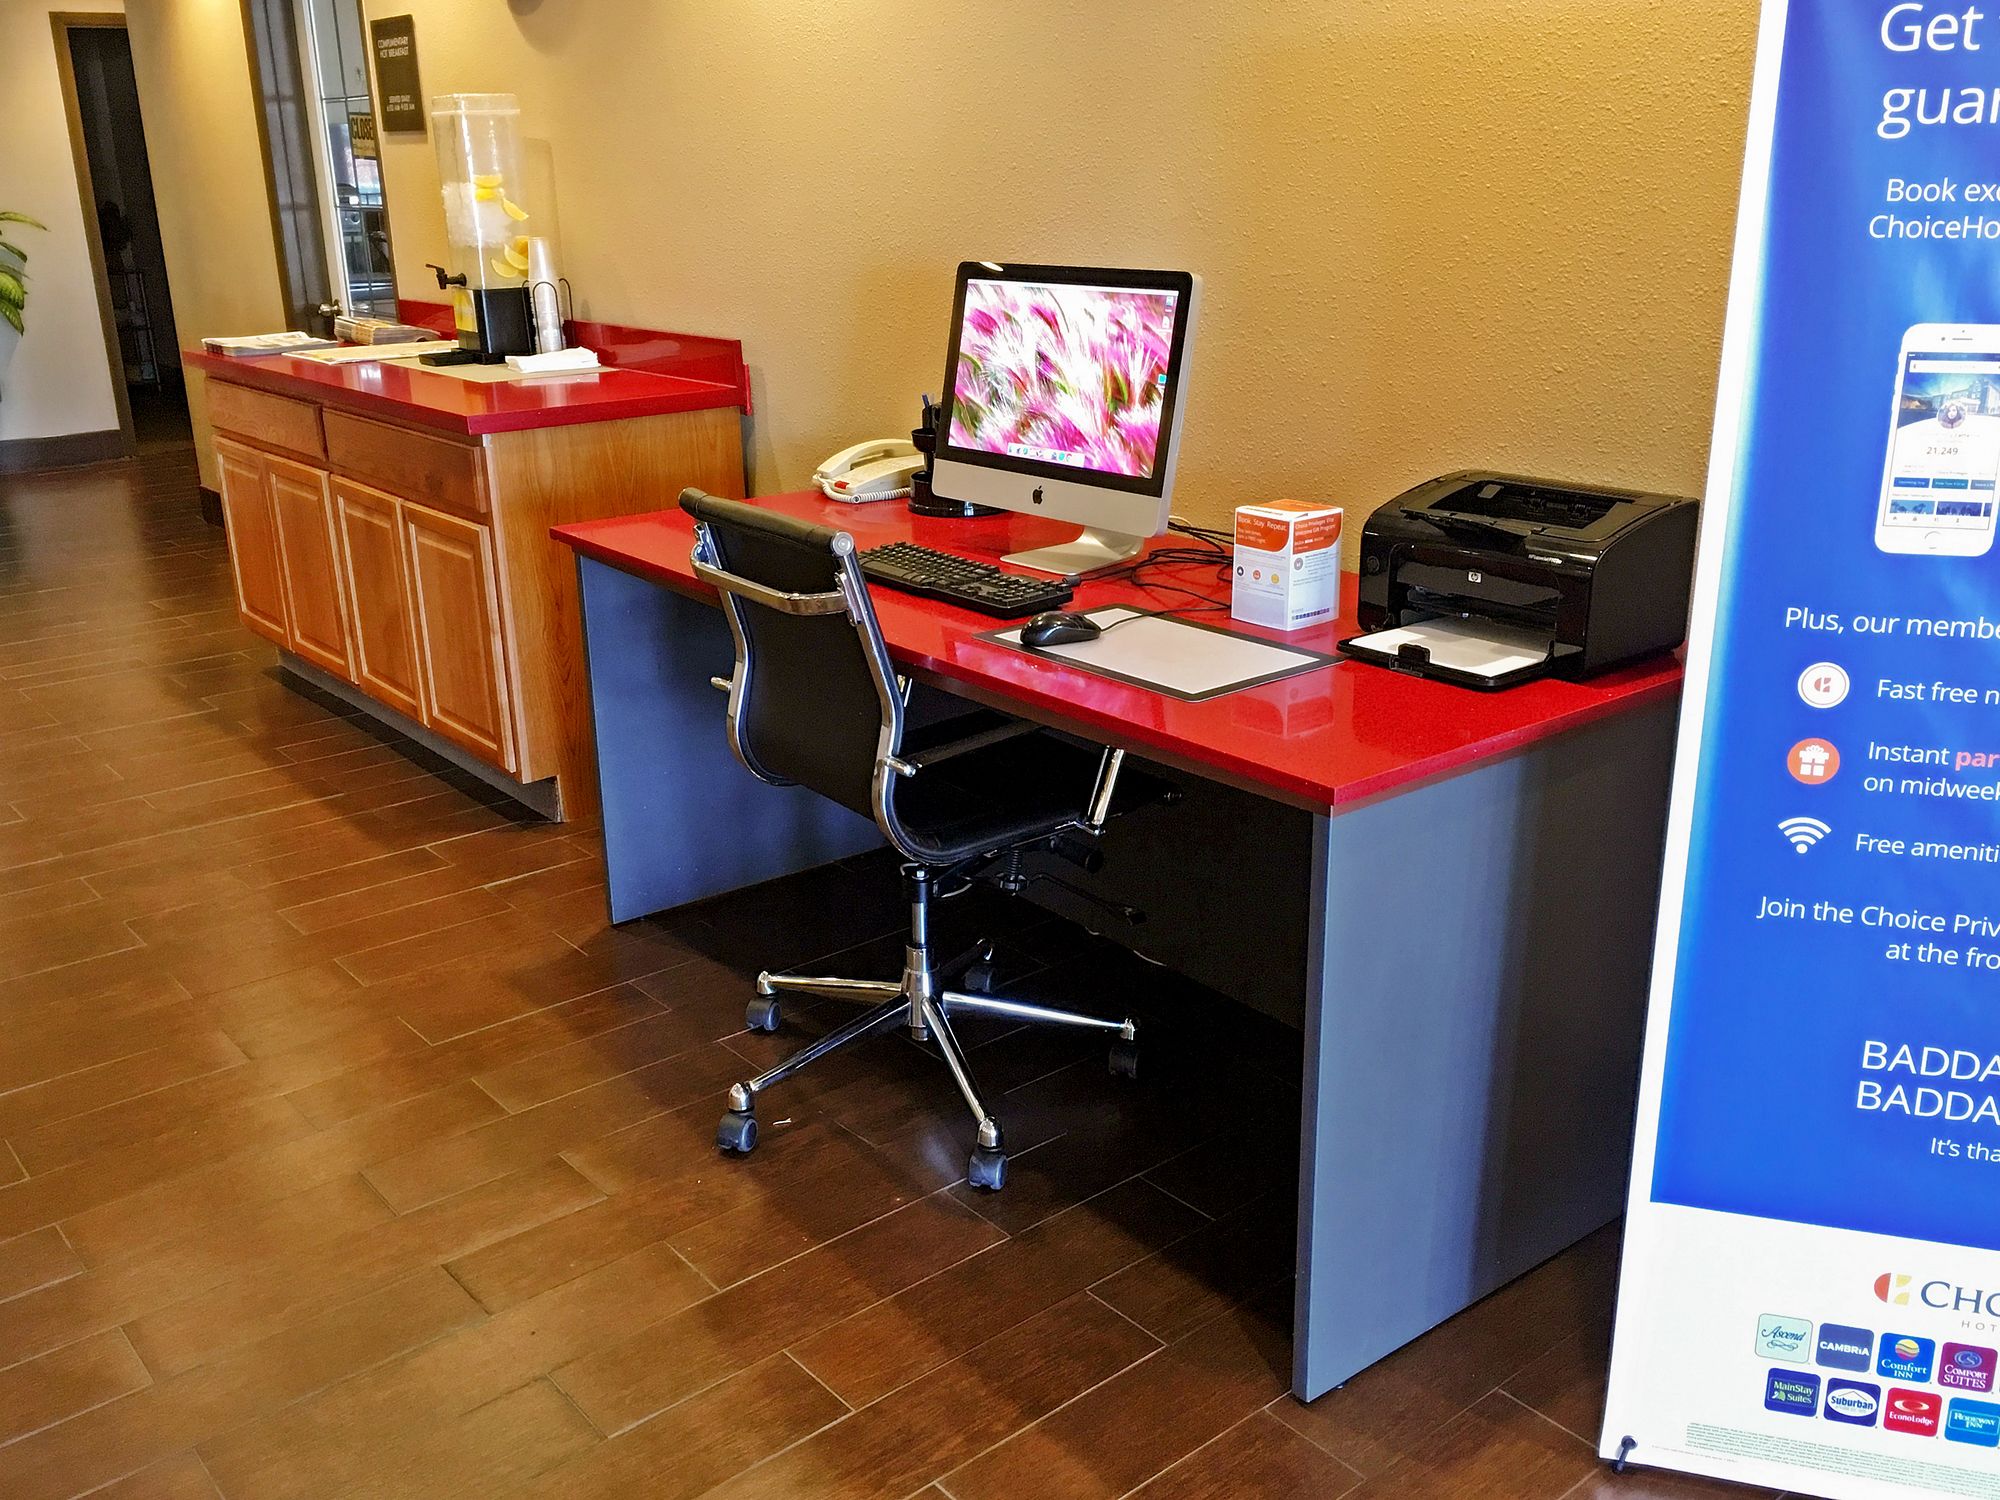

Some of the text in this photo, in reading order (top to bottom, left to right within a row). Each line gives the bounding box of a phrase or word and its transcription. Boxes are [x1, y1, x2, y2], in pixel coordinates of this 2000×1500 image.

[1881, 3, 1984, 51] Get
[1886, 177, 2000, 202] Book ex
[1869, 214, 2000, 239] ChoiceHo
[1785, 607, 1844, 634] Plus,
[1853, 615, 1901, 634] our
[1877, 679, 1926, 701] Fast
[1931, 681, 1978, 704] free
[1868, 741, 1950, 765] Instant
[1863, 776, 1893, 793] on
[1855, 833, 2000, 863] Free ameniti
[1756, 896, 2000, 937] Join the Choice Priv
[1885, 942, 2000, 970] at the fro
[1861, 1040, 2000, 1082] BADDA
[1856, 1080, 2000, 1126] BADDA
[1930, 1137, 1960, 1157] It's
[1762, 1325, 1807, 1342] Ascend
[1961, 1320, 1997, 1333] HOT
[1881, 1359, 1927, 1374] Comfort
[1893, 1369, 1914, 1379] INN
[1773, 1381, 1814, 1396] MainStay
[1943, 1374, 1987, 1389] SUITES
[1786, 1394, 1812, 1404] Suites
[1831, 1395, 1874, 1410] Suburban
[1965, 1420, 1984, 1429] INN
